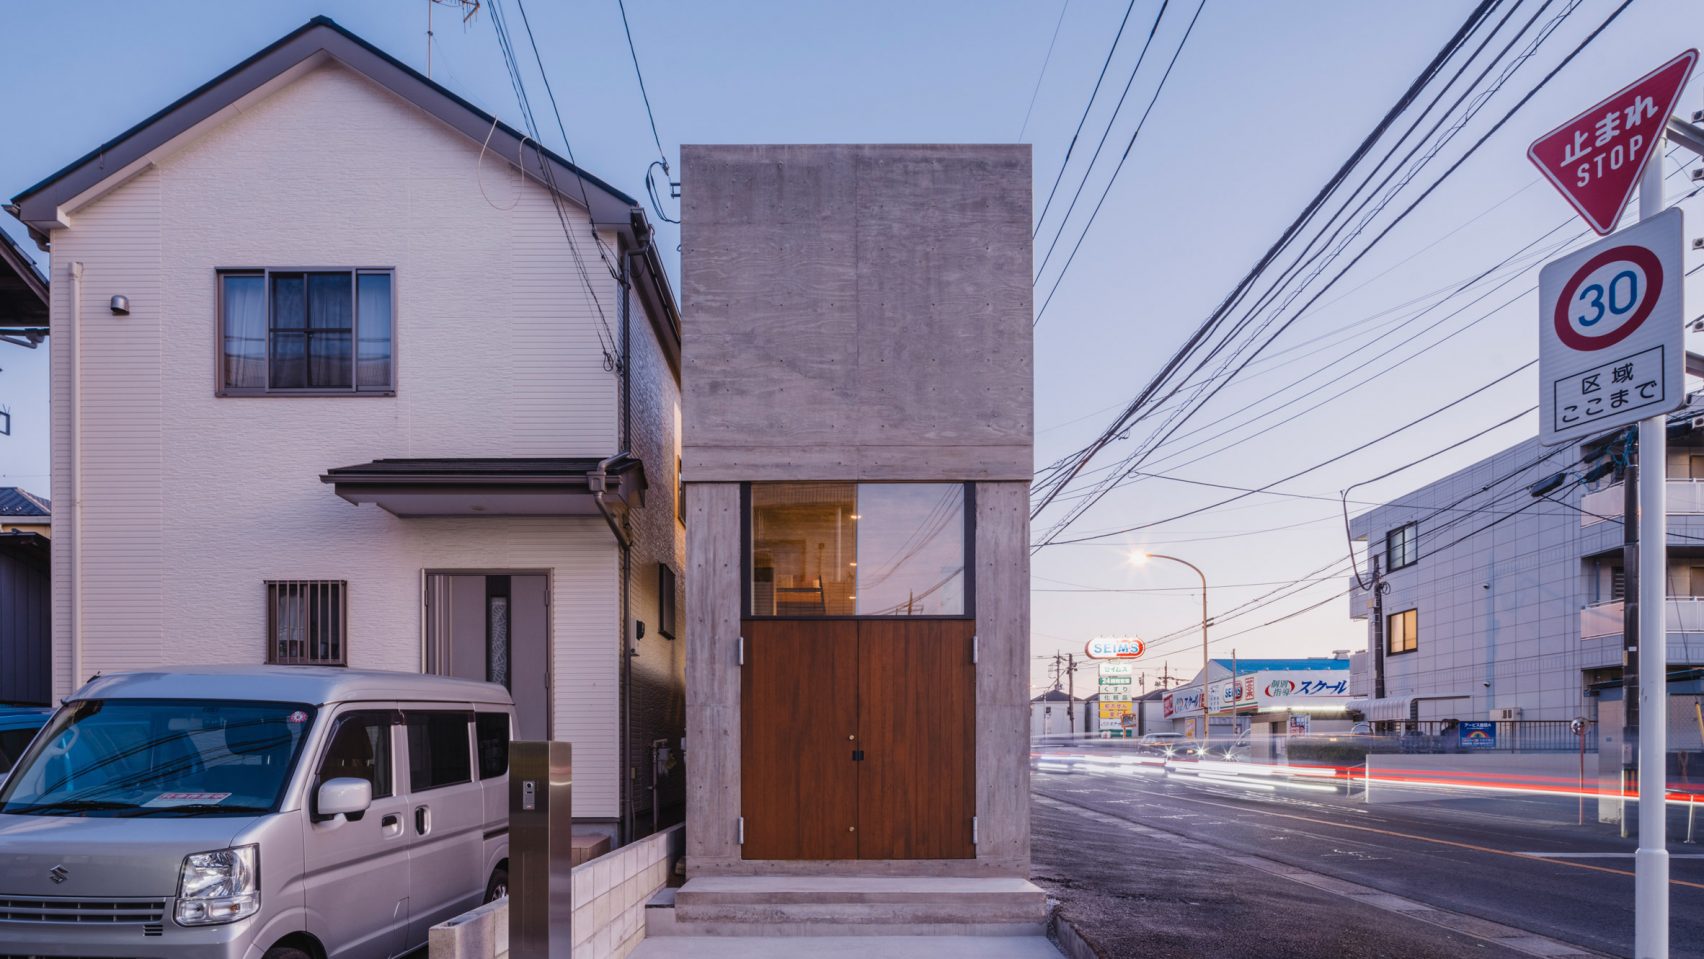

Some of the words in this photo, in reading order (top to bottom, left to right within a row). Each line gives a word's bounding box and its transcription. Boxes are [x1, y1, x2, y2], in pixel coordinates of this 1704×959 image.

[1560, 95, 1659, 168] 止まれ
[1577, 135, 1643, 188] STOP
[1578, 270, 1638, 327] 30
[1582, 362, 1634, 395] 区域
[1562, 380, 1657, 423] ここまで
[1094, 643, 1139, 654] SEIMS
[1294, 680, 1347, 695] スクール
